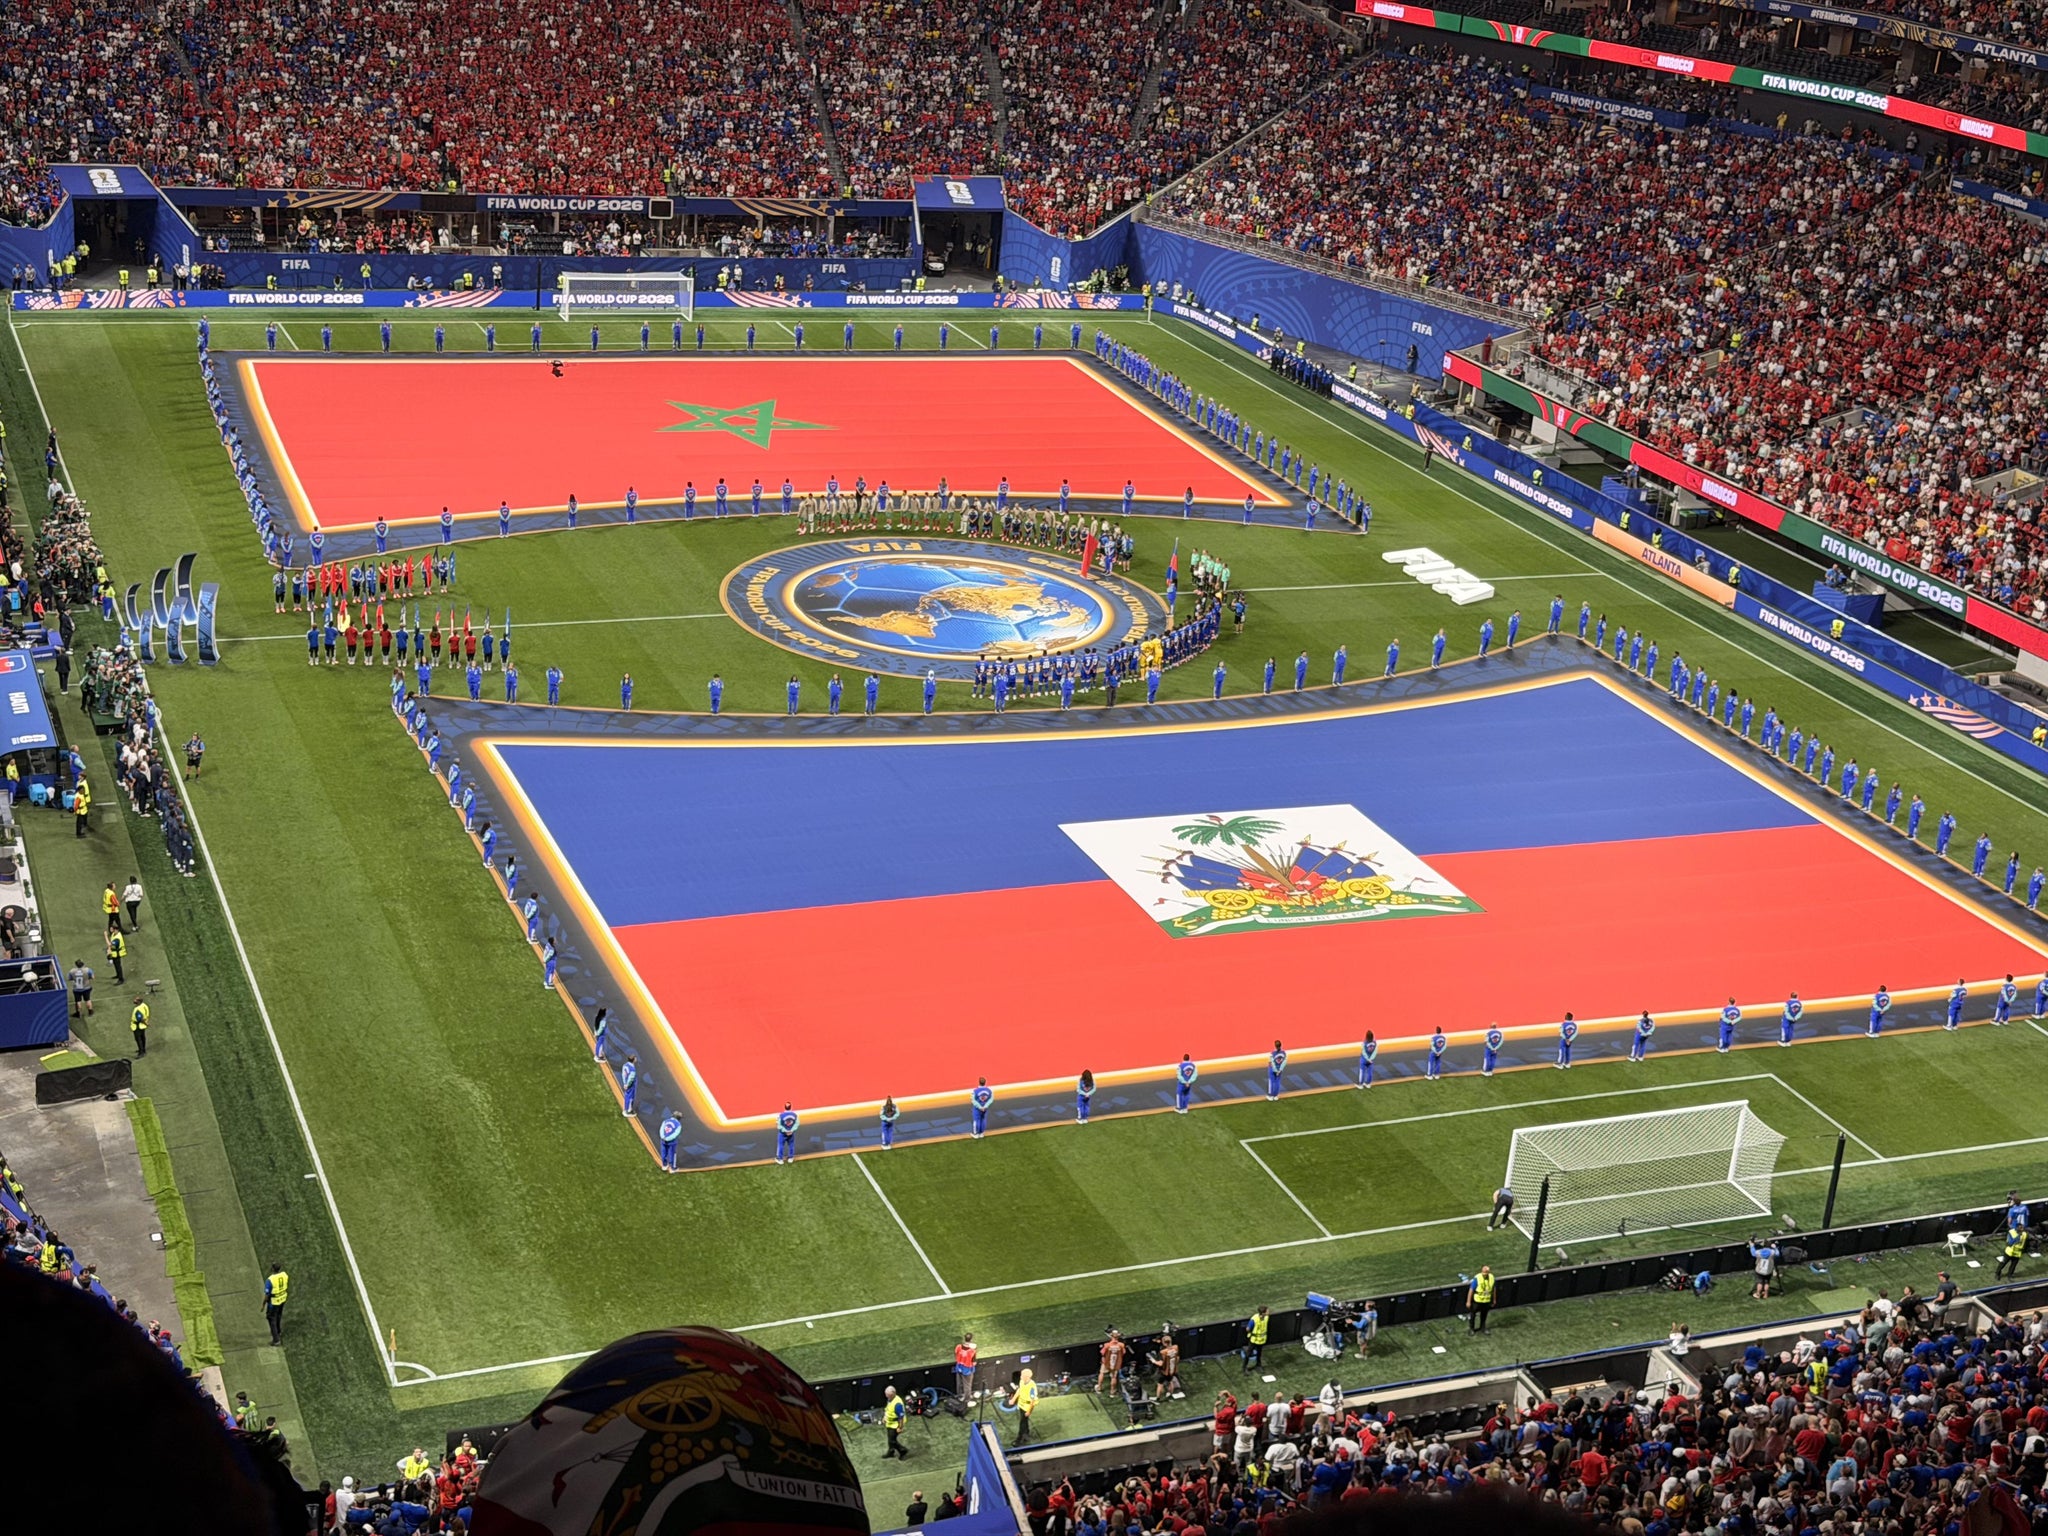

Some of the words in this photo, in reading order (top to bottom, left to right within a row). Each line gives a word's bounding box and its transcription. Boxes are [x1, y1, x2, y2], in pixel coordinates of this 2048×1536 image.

[1973, 43, 2037, 66] ATLANTA
[1762, 74, 1786, 90] FIFA
[1787, 79, 1830, 97] WORLD
[1831, 87, 1855, 102] CUP
[1855, 92, 1888, 110] 2026
[1550, 92, 1569, 104] FIFA
[1602, 102, 1620, 113] CUP
[1620, 106, 1654, 121] 2026
[487, 198, 516, 210] FIFA
[518, 198, 567, 210] WORLD
[569, 199, 596, 211] CUP
[597, 200, 644, 211] 2026
[282, 259, 310, 270] FIFA
[822, 263, 846, 273] FIFA
[228, 294, 254, 304] FIFA
[253, 294, 298, 304] WORLD
[299, 294, 323, 304] CUP
[323, 294, 364, 304] 2026
[577, 295, 616, 304] WORLD
[616, 295, 637, 304] CUP
[638, 295, 675, 304] 2026
[846, 295, 868, 304] FIFA
[867, 295, 904, 304] WORLD
[904, 295, 924, 304] CUP
[924, 295, 959, 304] 2026
[1173, 304, 1190, 318] FIFA
[1189, 309, 1210, 326] WORLD
[1208, 317, 1220, 332] CUP
[1218, 323, 1236, 340] 2026
[1412, 322, 1432, 336] FIFA
[1336, 385, 1355, 403] WORLD
[1354, 396, 1366, 409] CUP
[1365, 402, 1387, 420] 2026
[1494, 469, 1509, 485] FIFA
[1508, 476, 1533, 497] WORLD
[1532, 488, 1548, 505] CUP
[1547, 497, 1573, 519] 2026
[1701, 478, 1738, 506] MOROCCO
[846, 542, 922, 553] FIFA
[750, 566, 781, 584] FIFA
[1382, 547, 1495, 606] FIFA
[1642, 547, 1682, 578] ATLANTA
[1820, 535, 1847, 558] FIFA
[1848, 546, 1891, 578] WORLD
[1892, 567, 1918, 590] CUP
[1917, 579, 1964, 613] 2026
[746, 584, 770, 614] WORLD
[1096, 580, 1129, 596] CUP
[760, 613, 791, 632] CUP
[1122, 595, 1149, 625] WORLD
[784, 630, 861, 659] 2026
[1759, 608, 1779, 628] FIFA
[1779, 619, 1812, 644] WORLD
[1811, 636, 1832, 656] CUP
[1830, 645, 1865, 672] 2026
[743, 1471, 807, 1498] L'UNION
[814, 1483, 846, 1504] FAIT
